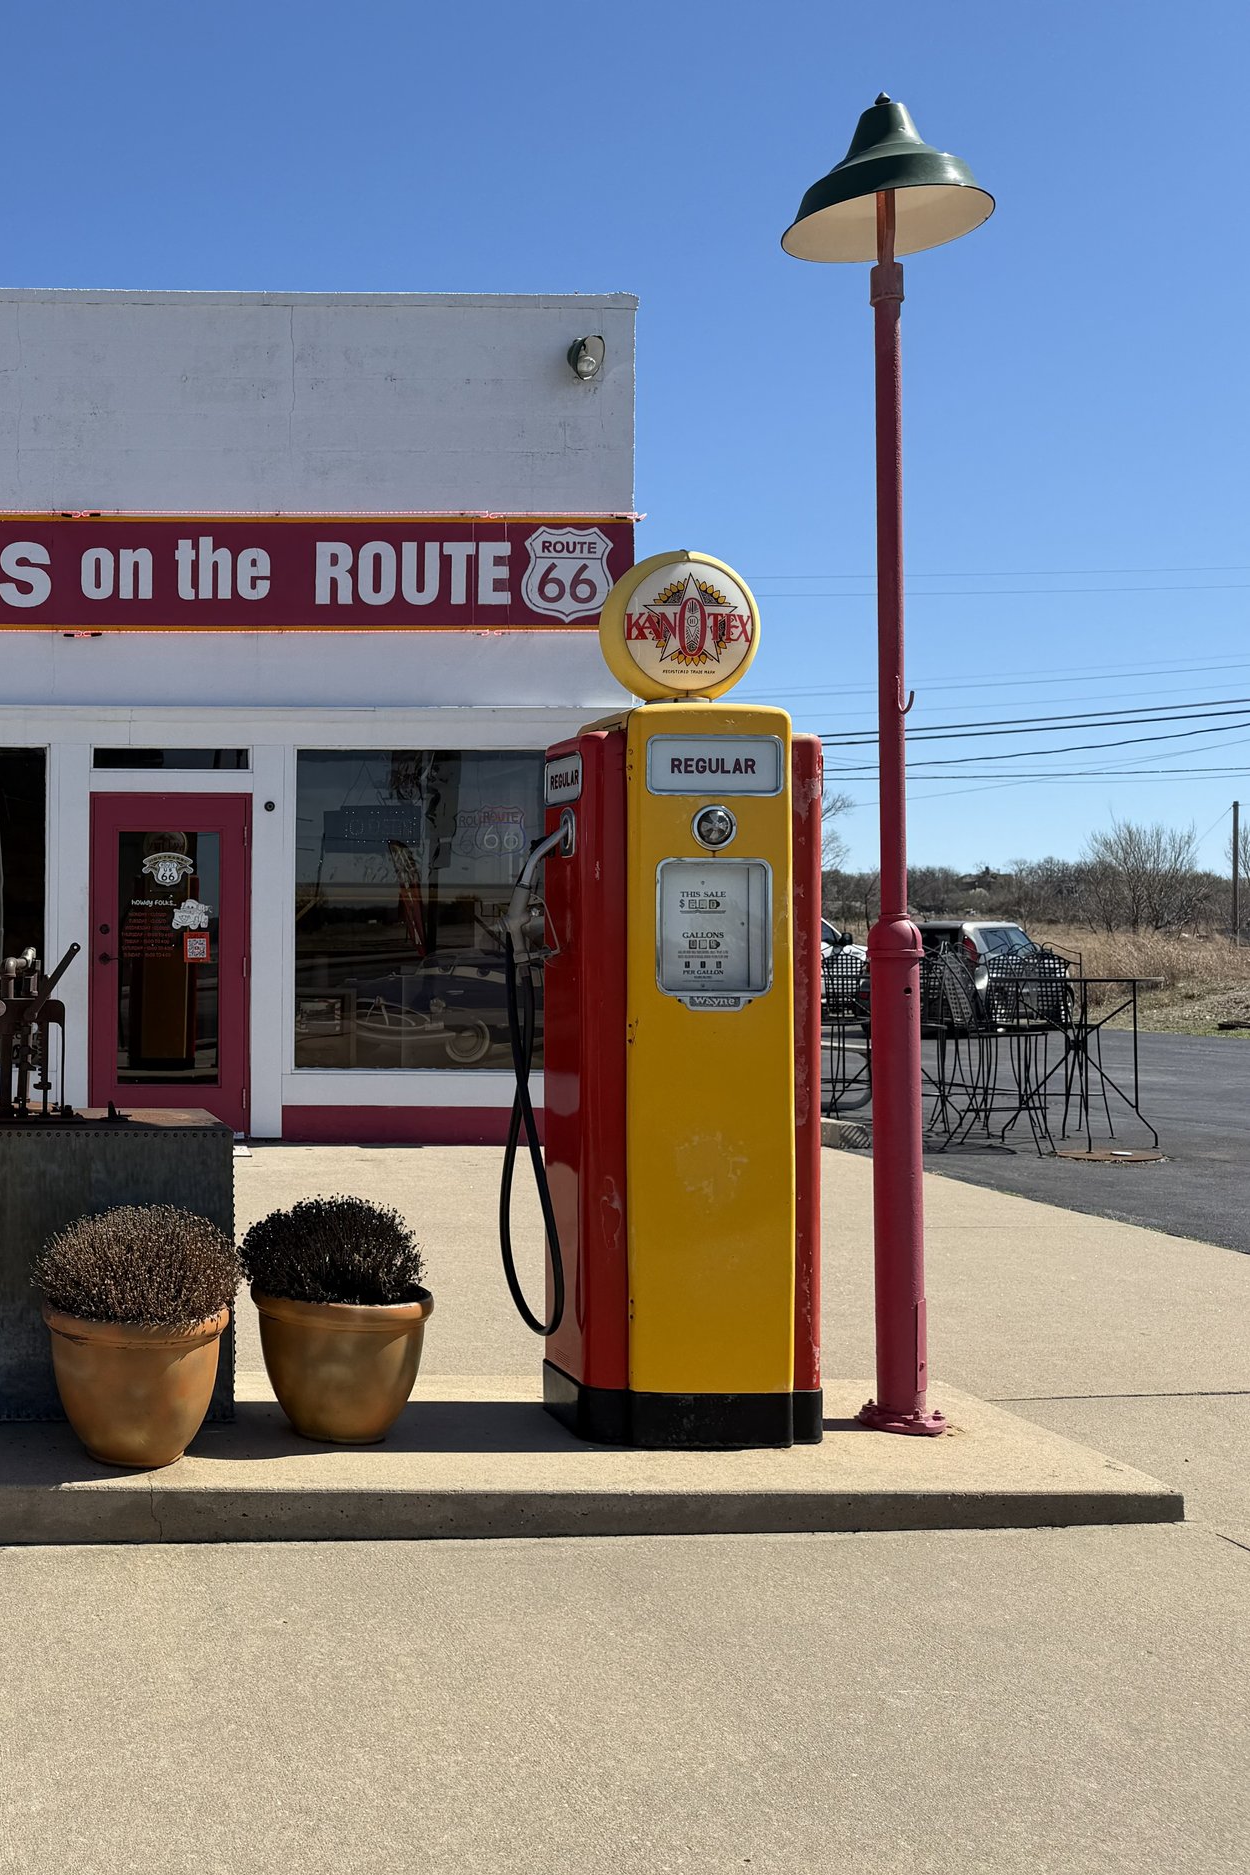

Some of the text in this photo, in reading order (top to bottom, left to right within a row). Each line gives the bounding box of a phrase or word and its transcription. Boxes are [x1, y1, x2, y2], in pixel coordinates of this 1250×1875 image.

[541, 540, 598, 555] ROUTE
[81, 547, 153, 600] on
[175, 536, 271, 600] the
[315, 540, 512, 606] ROUTE
[537, 562, 598, 604] 66
[670, 757, 756, 775] REGULAR
[550, 768, 579, 791] REGULAR
[483, 811, 519, 823] ROUTE
[483, 824, 519, 849] 66
[161, 872, 175, 881] 66
[682, 931, 725, 939] GALLONS
[694, 996, 735, 1007] Wayne
